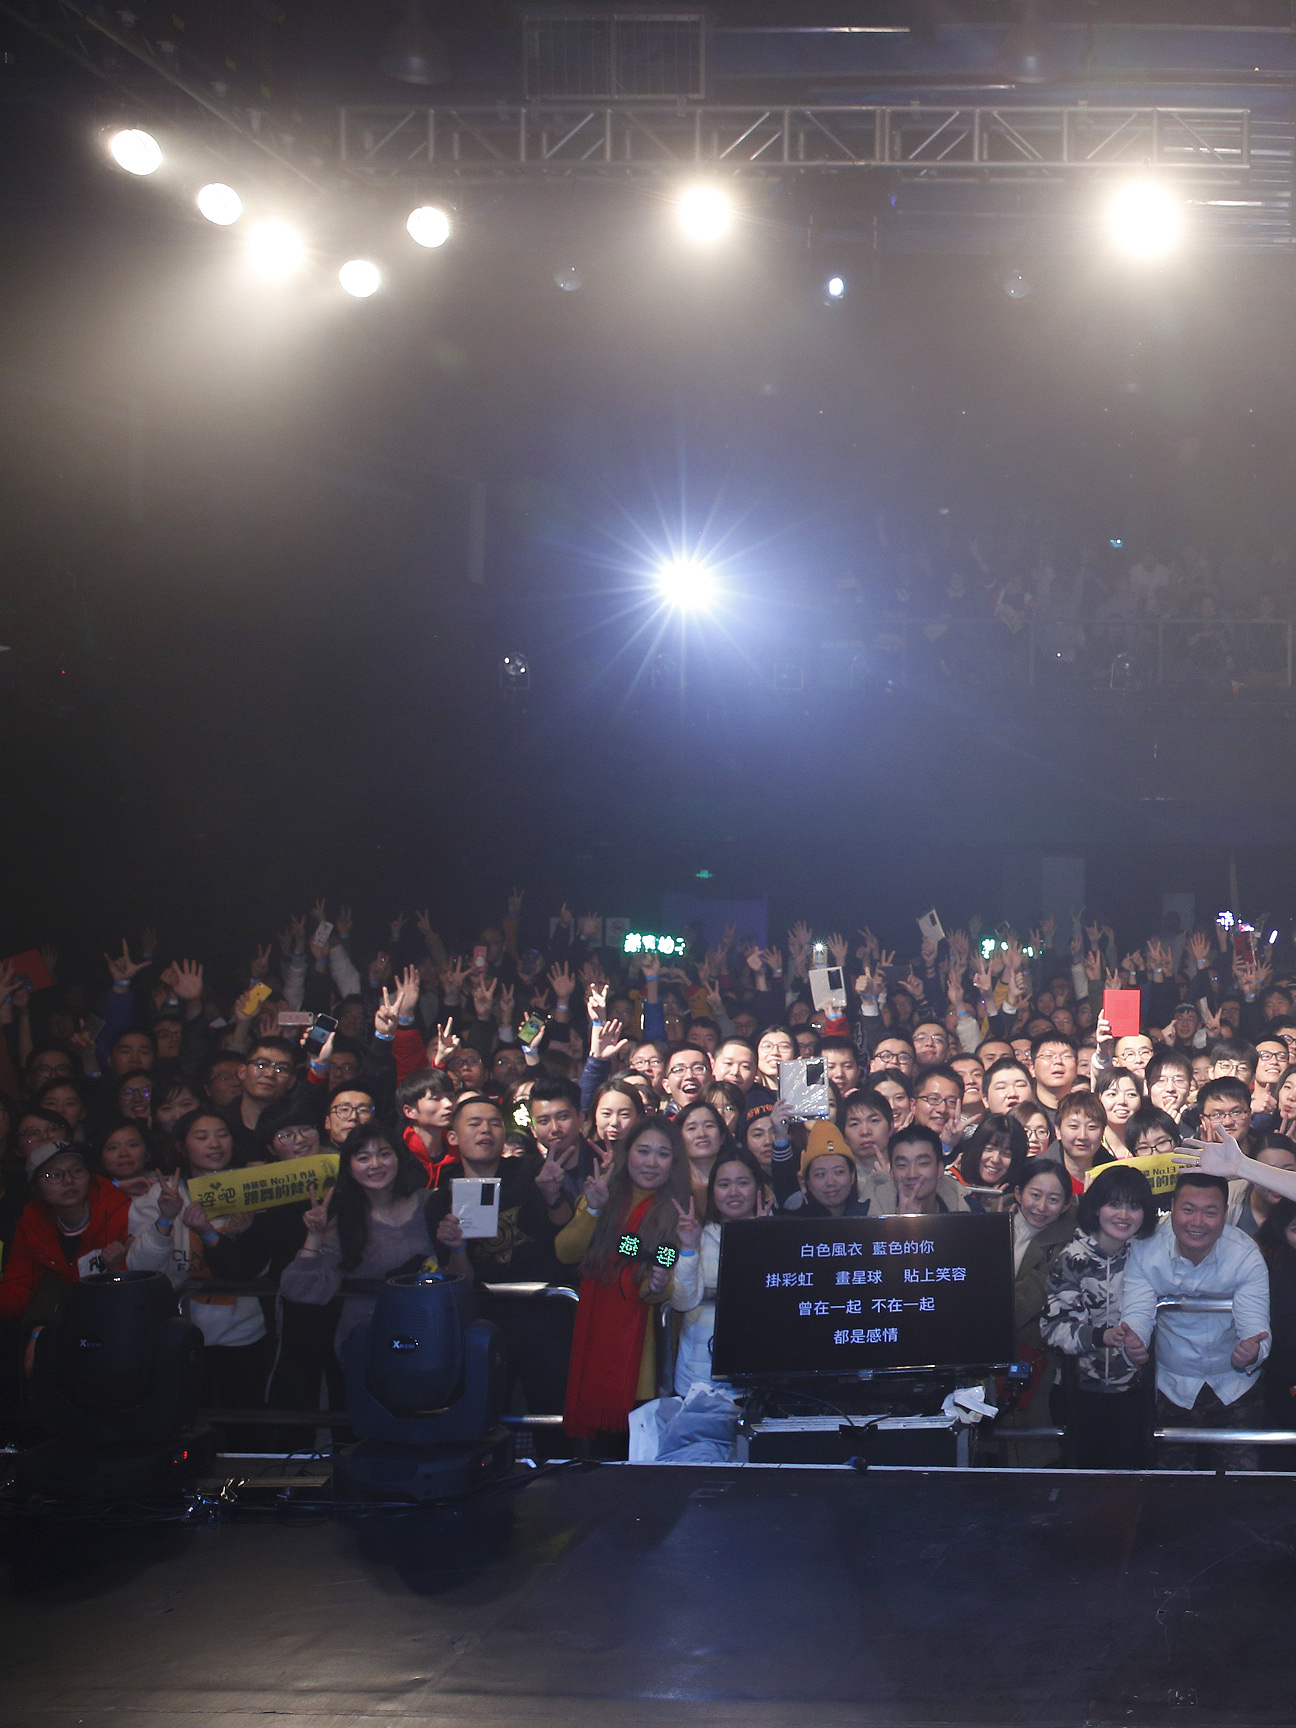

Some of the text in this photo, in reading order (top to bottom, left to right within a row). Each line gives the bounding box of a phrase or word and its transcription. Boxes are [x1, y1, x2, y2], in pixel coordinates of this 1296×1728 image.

[618, 1235, 640, 1257] 燕
[800, 1239, 934, 1258] 白色風衣 藍色的你
[765, 1266, 967, 1288] 掛彩虹 畫星球 貼上笑容
[798, 1297, 935, 1316] 曾在一起 不在一起
[833, 1328, 899, 1345] 都是感情
